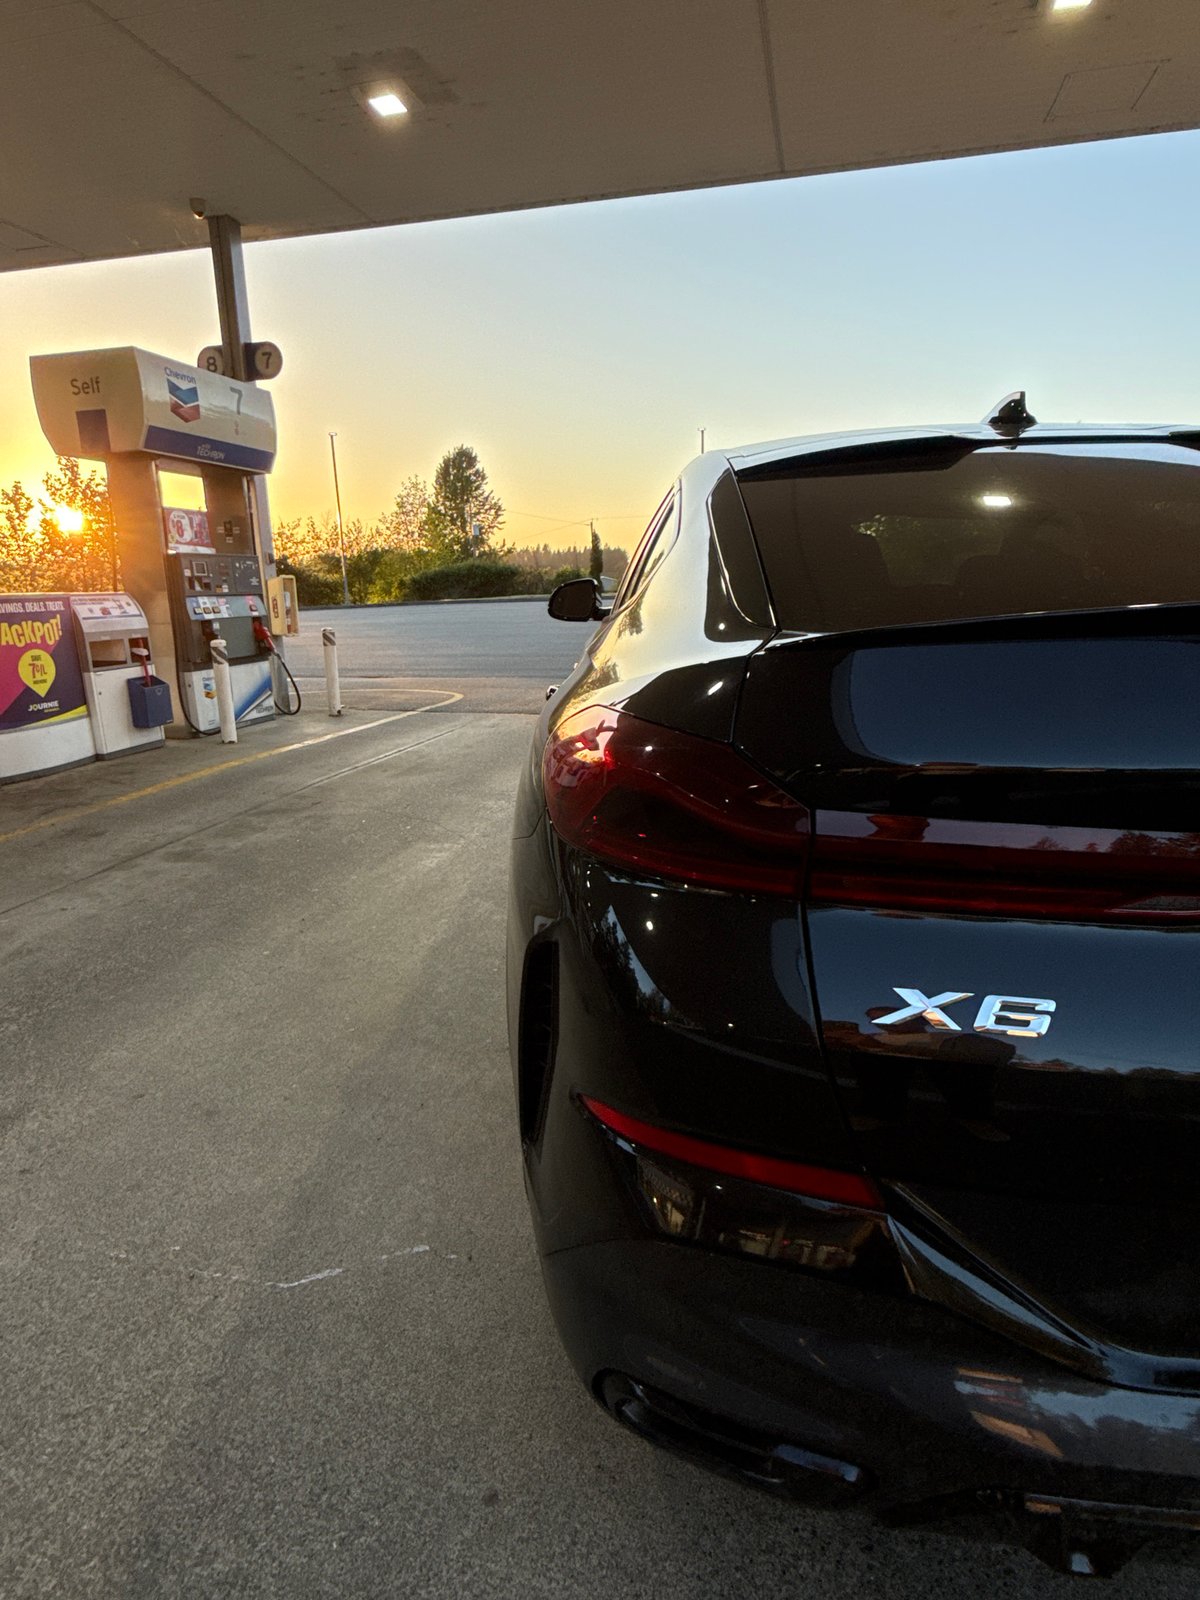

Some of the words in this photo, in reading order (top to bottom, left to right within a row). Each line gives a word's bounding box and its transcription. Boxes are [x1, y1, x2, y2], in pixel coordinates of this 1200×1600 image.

[206, 356, 218, 373] 8
[261, 351, 273, 370] 7
[164, 366, 197, 385] Chevron
[70, 376, 101, 396] Self
[229, 386, 243, 417] 7
[28, 700, 59, 712] JOURNIE
[871, 987, 1057, 1038] X6
